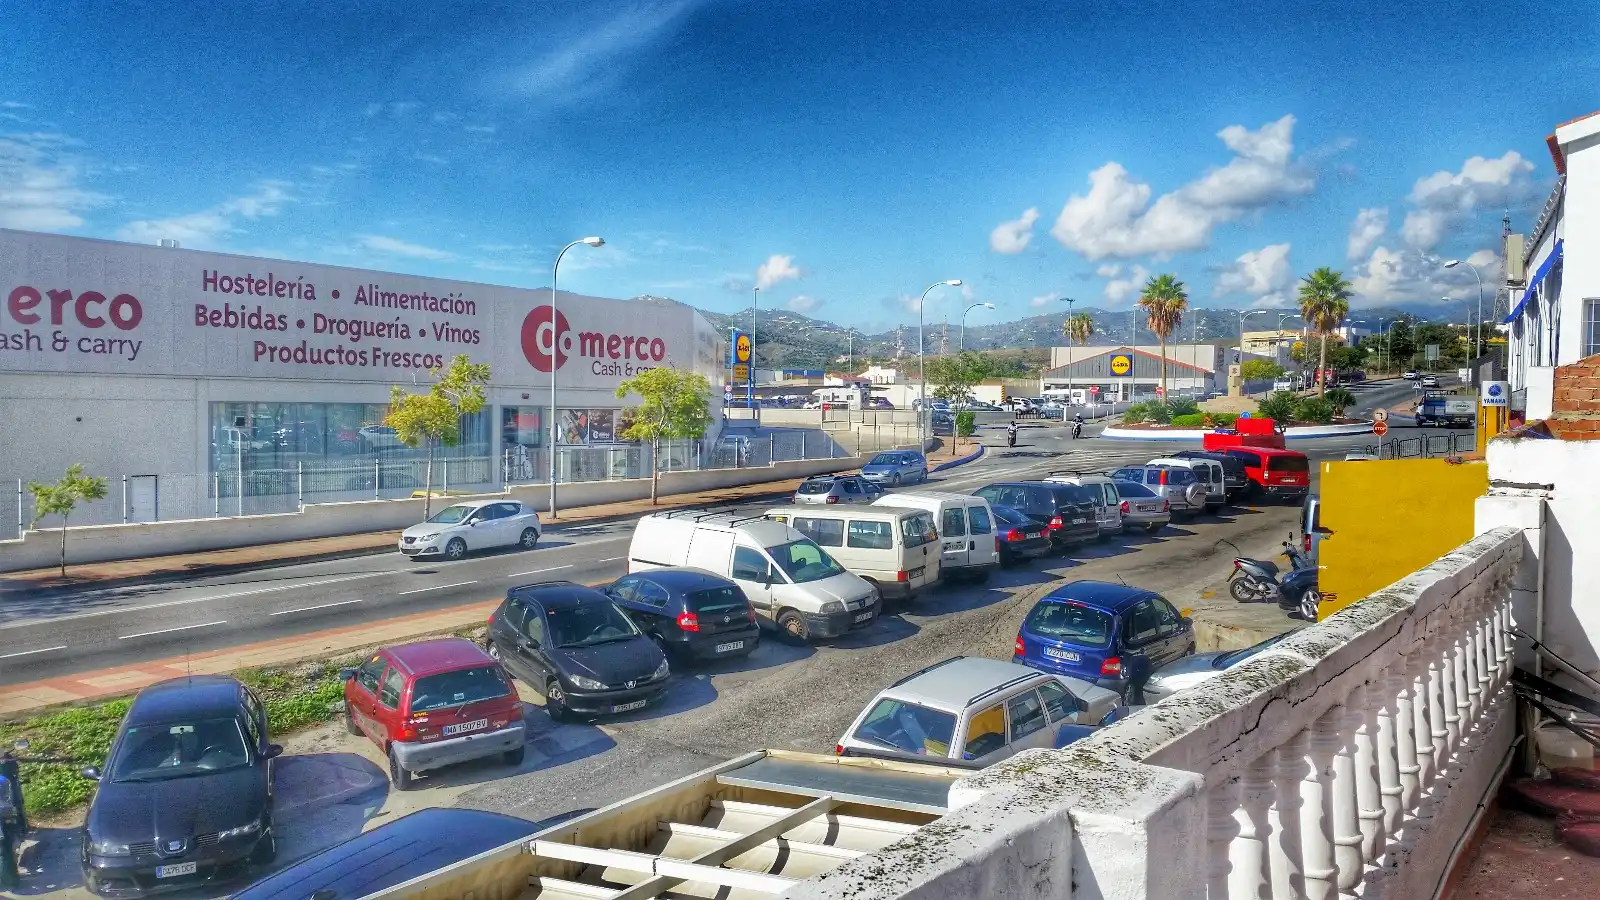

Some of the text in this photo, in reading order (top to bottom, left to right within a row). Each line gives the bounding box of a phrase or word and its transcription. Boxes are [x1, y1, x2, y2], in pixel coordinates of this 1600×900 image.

[203, 269, 316, 301] Hostelería
[354, 283, 476, 316] Alimentación
[195, 303, 480, 345] Bebidas Droguería Vinos
[52, 330, 70, 352] &
[77, 337, 142, 361] carry
[254, 340, 443, 369] Productos Frescos
[591, 360, 621, 376] Cash
[625, 362, 633, 377] &
